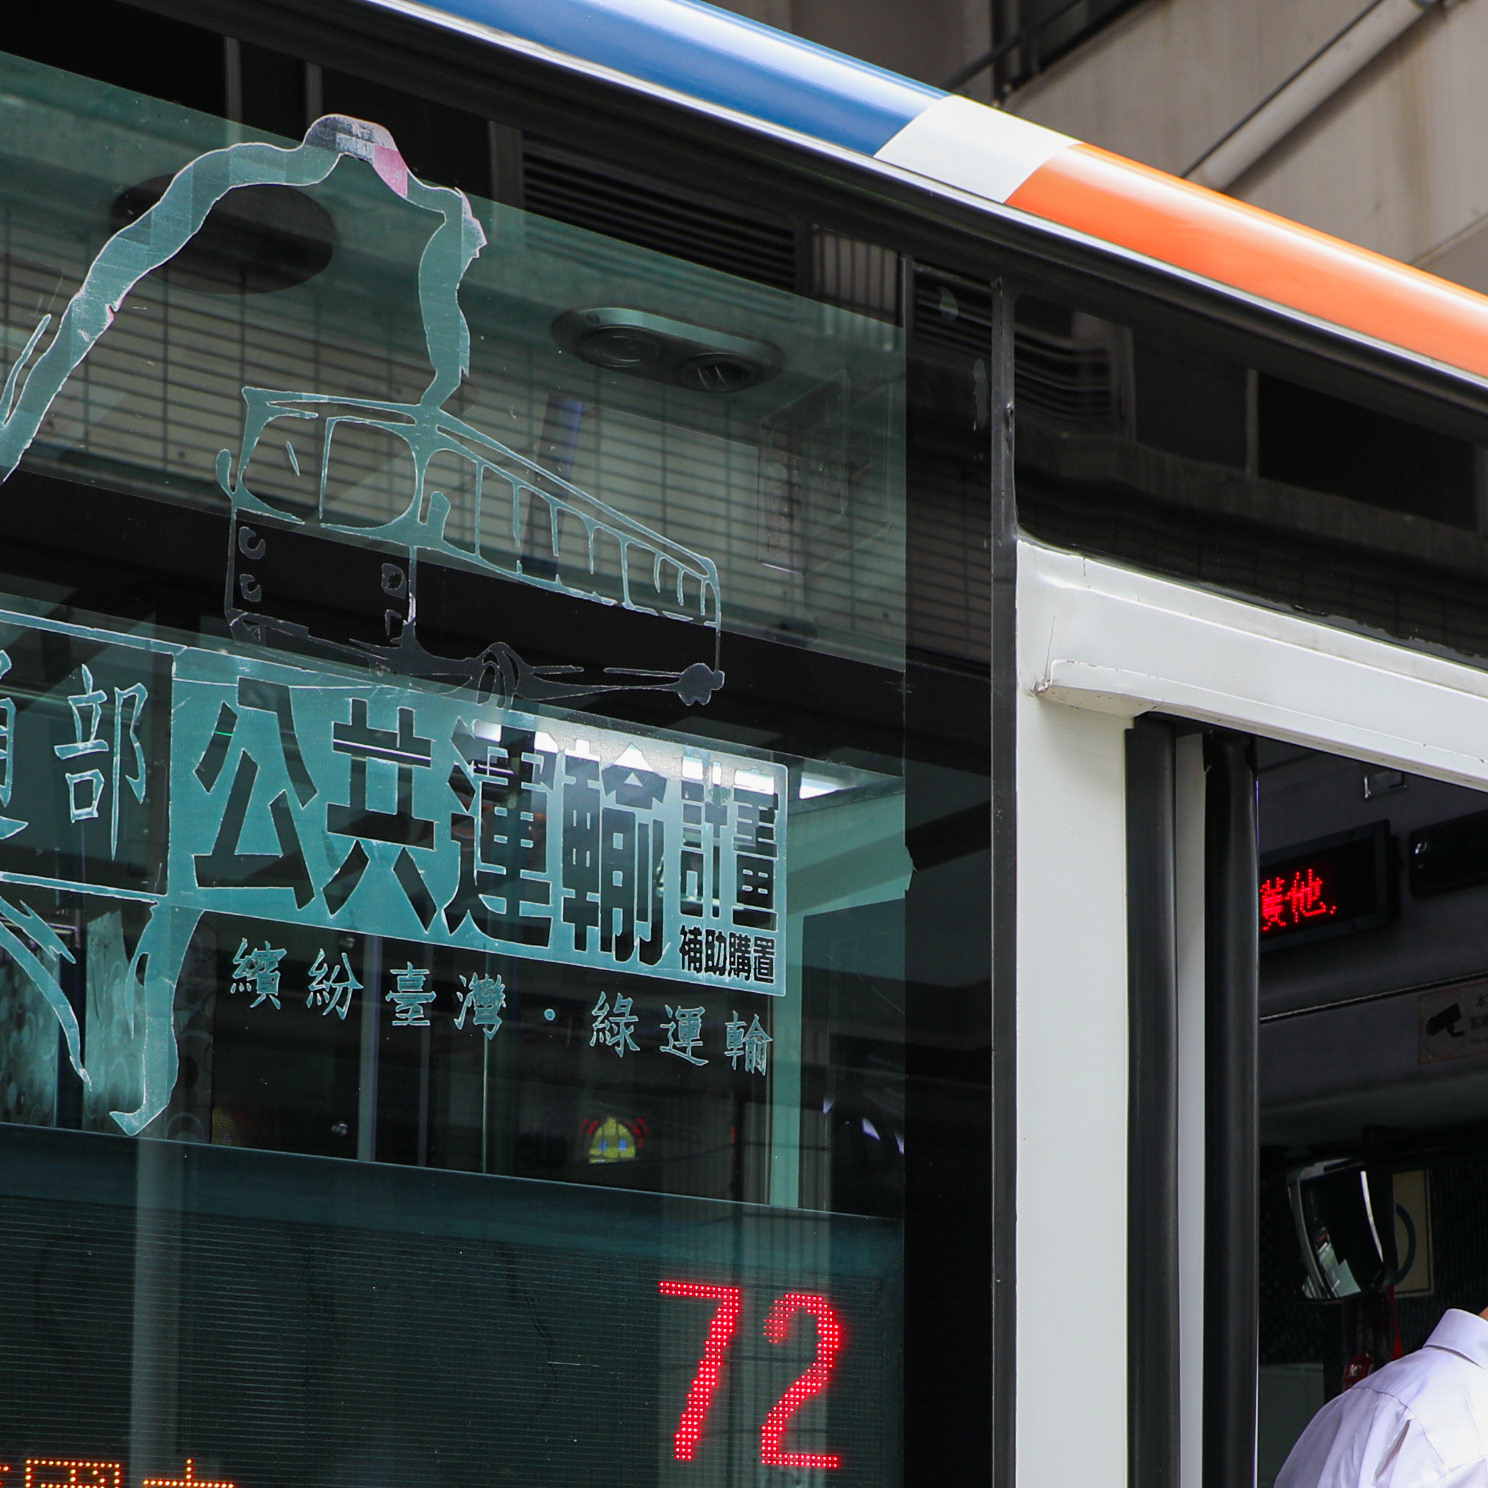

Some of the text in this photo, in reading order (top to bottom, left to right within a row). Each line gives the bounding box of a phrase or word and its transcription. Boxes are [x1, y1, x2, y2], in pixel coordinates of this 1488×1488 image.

[193, 677, 781, 969] 公共運輸計畫
[679, 924, 776, 985] 補助購置
[657, 1278, 843, 1471] 72
